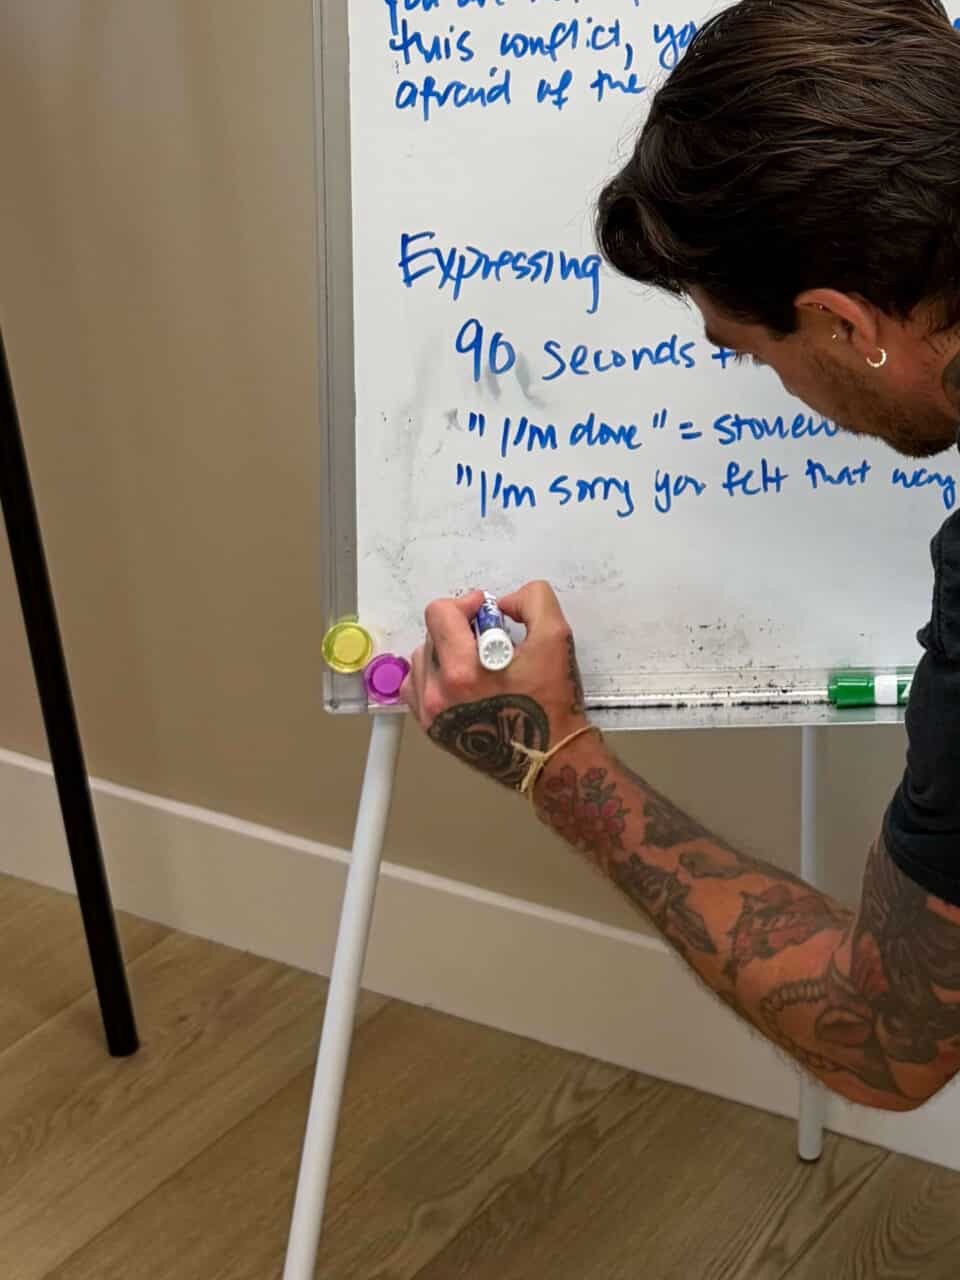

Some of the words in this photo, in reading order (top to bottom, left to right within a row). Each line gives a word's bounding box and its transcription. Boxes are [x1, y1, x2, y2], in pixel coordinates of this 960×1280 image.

[388, 17, 475, 65] this
[394, 66, 511, 122] afraid
[536, 69, 573, 111] of
[590, 69, 646, 101] the
[398, 231, 602, 315] Expressing
[455, 318, 517, 383] 90
[543, 335, 696, 381] seconds
[804, 458, 871, 490] that
